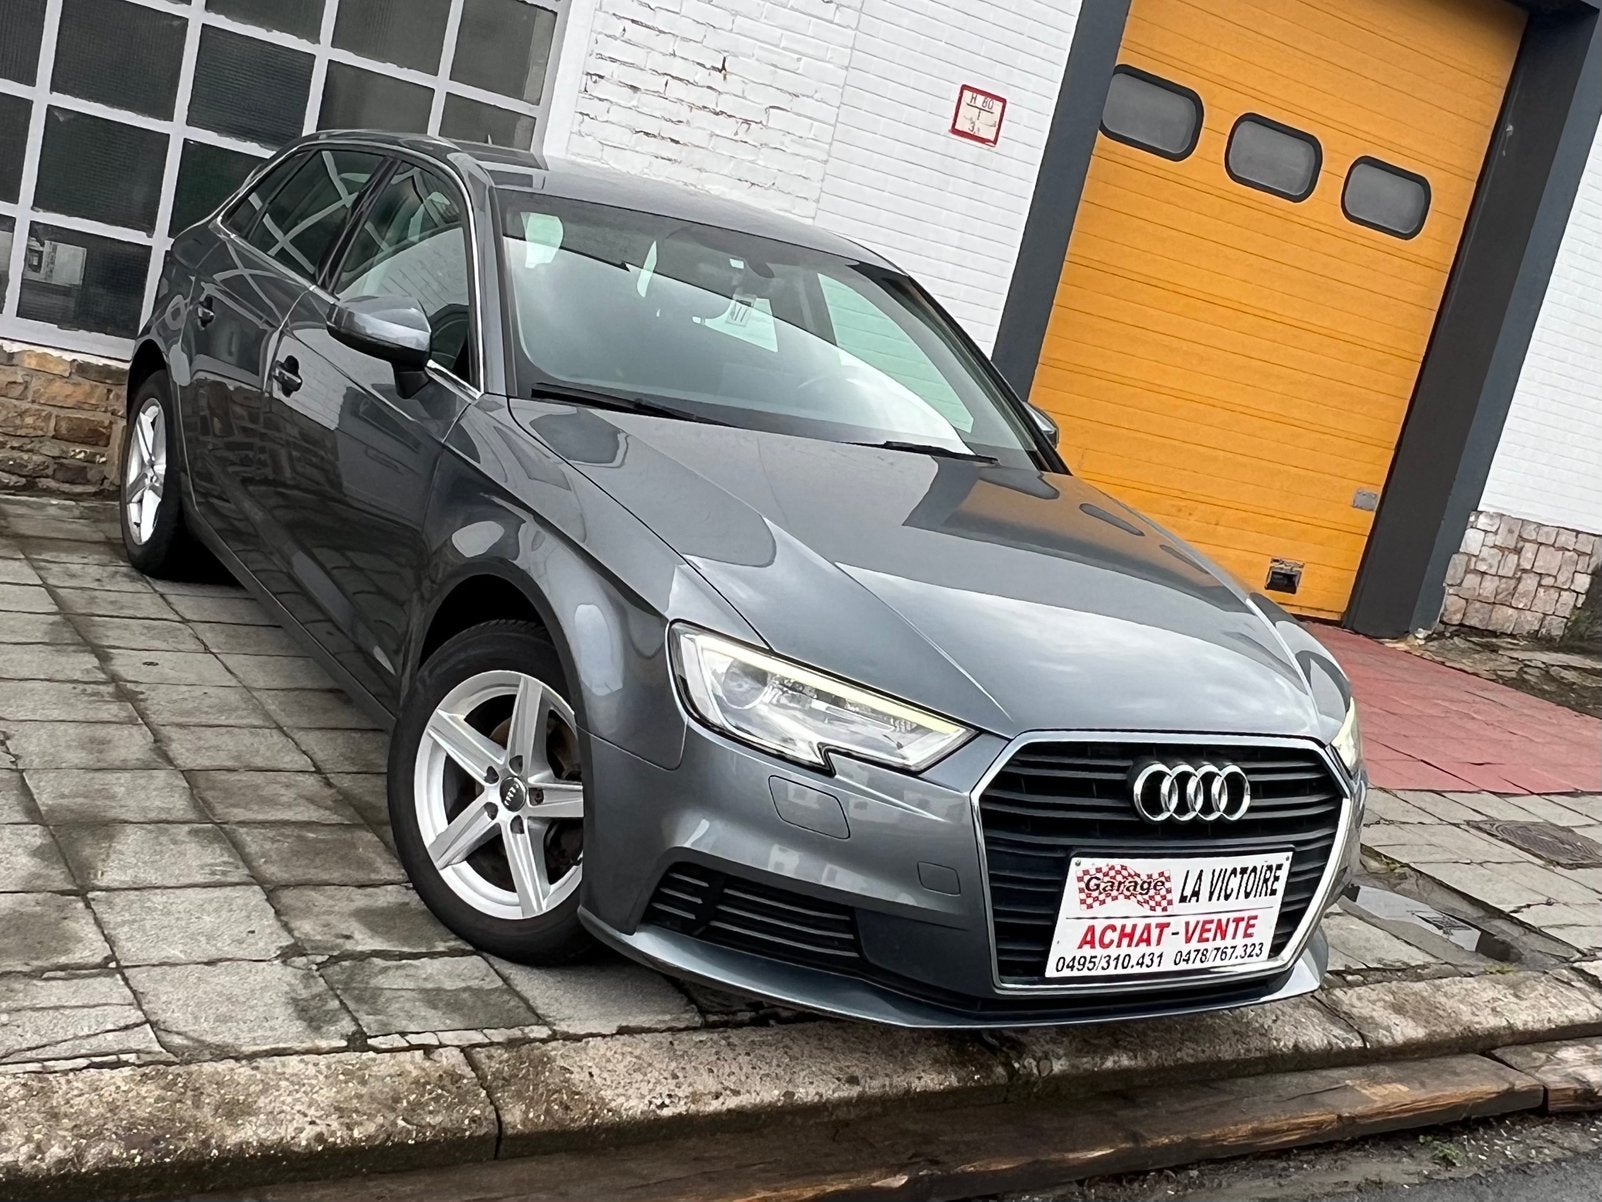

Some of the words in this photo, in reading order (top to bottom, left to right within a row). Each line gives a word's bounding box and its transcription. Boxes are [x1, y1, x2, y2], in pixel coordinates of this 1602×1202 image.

[970, 94, 977, 104] H
[1084, 876, 1165, 896] Garage
[1178, 869, 1204, 904] LA
[1207, 863, 1284, 902] VICTOIRE
[1055, 951, 1164, 973] 0495/310.431
[1173, 942, 1264, 966] 0478/767.323
